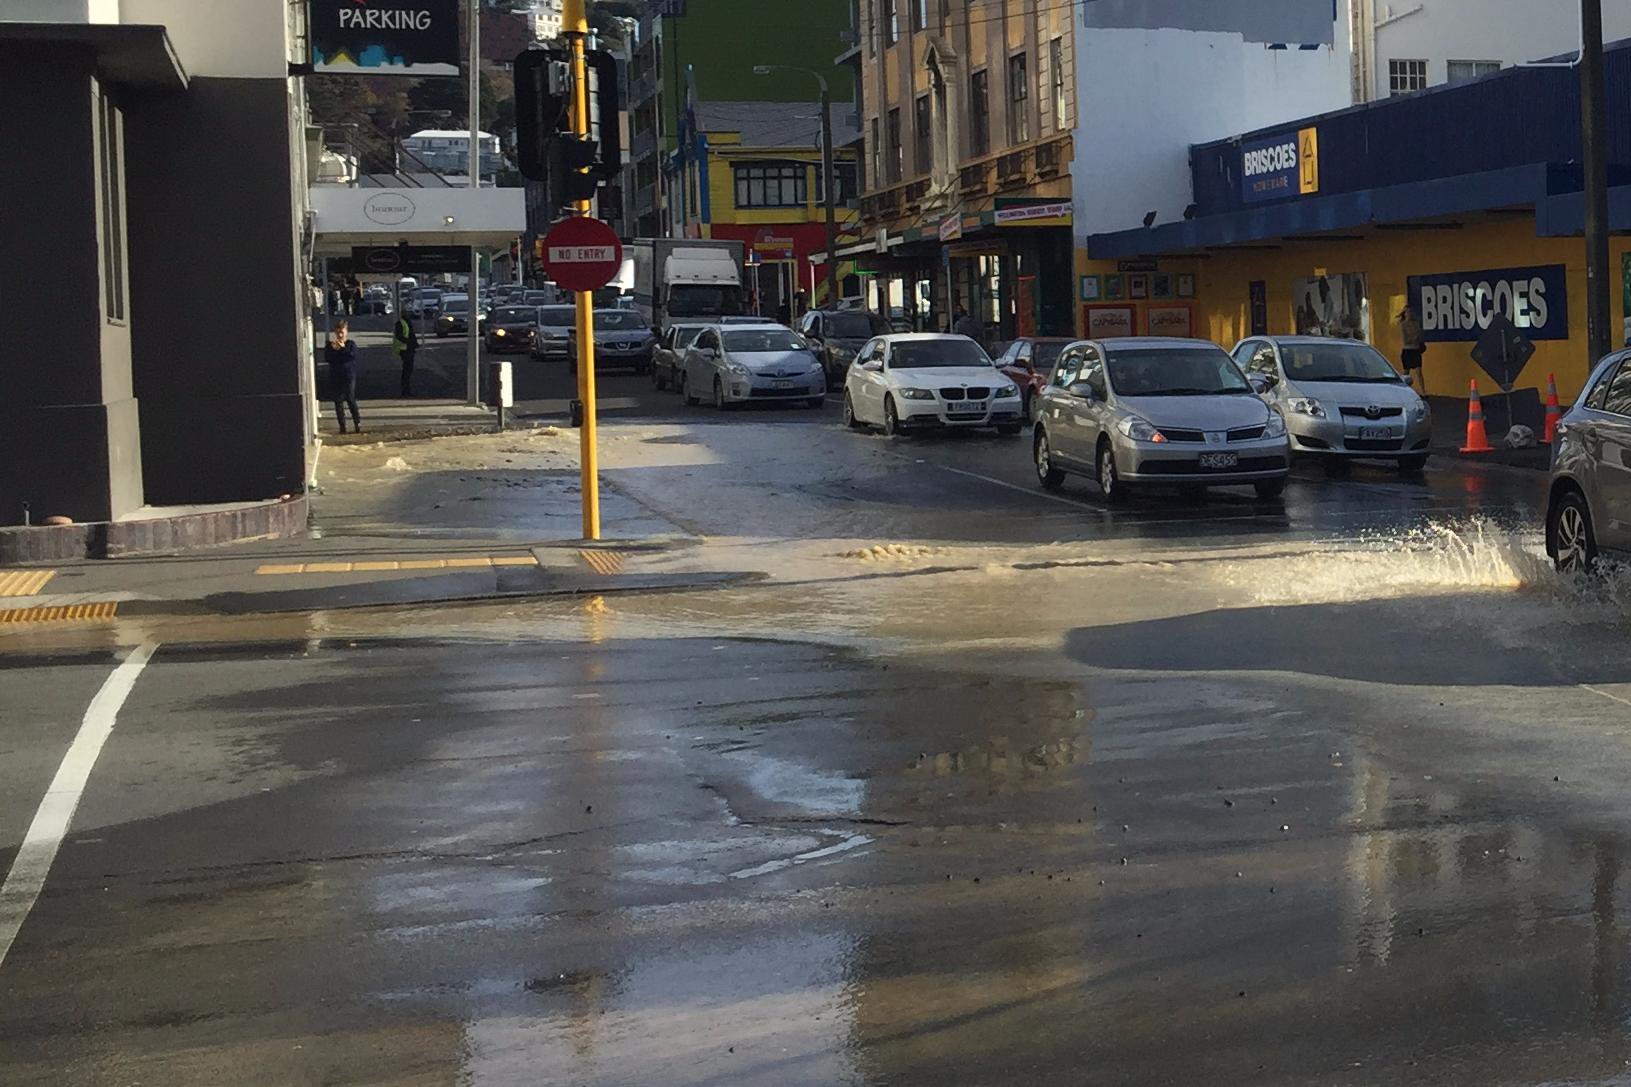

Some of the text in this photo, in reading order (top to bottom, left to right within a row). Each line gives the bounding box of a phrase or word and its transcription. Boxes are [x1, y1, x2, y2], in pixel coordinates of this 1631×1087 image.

[339, 8, 431, 30] PARKING
[1244, 142, 1297, 177] BRISCOES
[558, 248, 606, 260] NO ENTRY
[1421, 277, 1548, 330] BRISCOES
